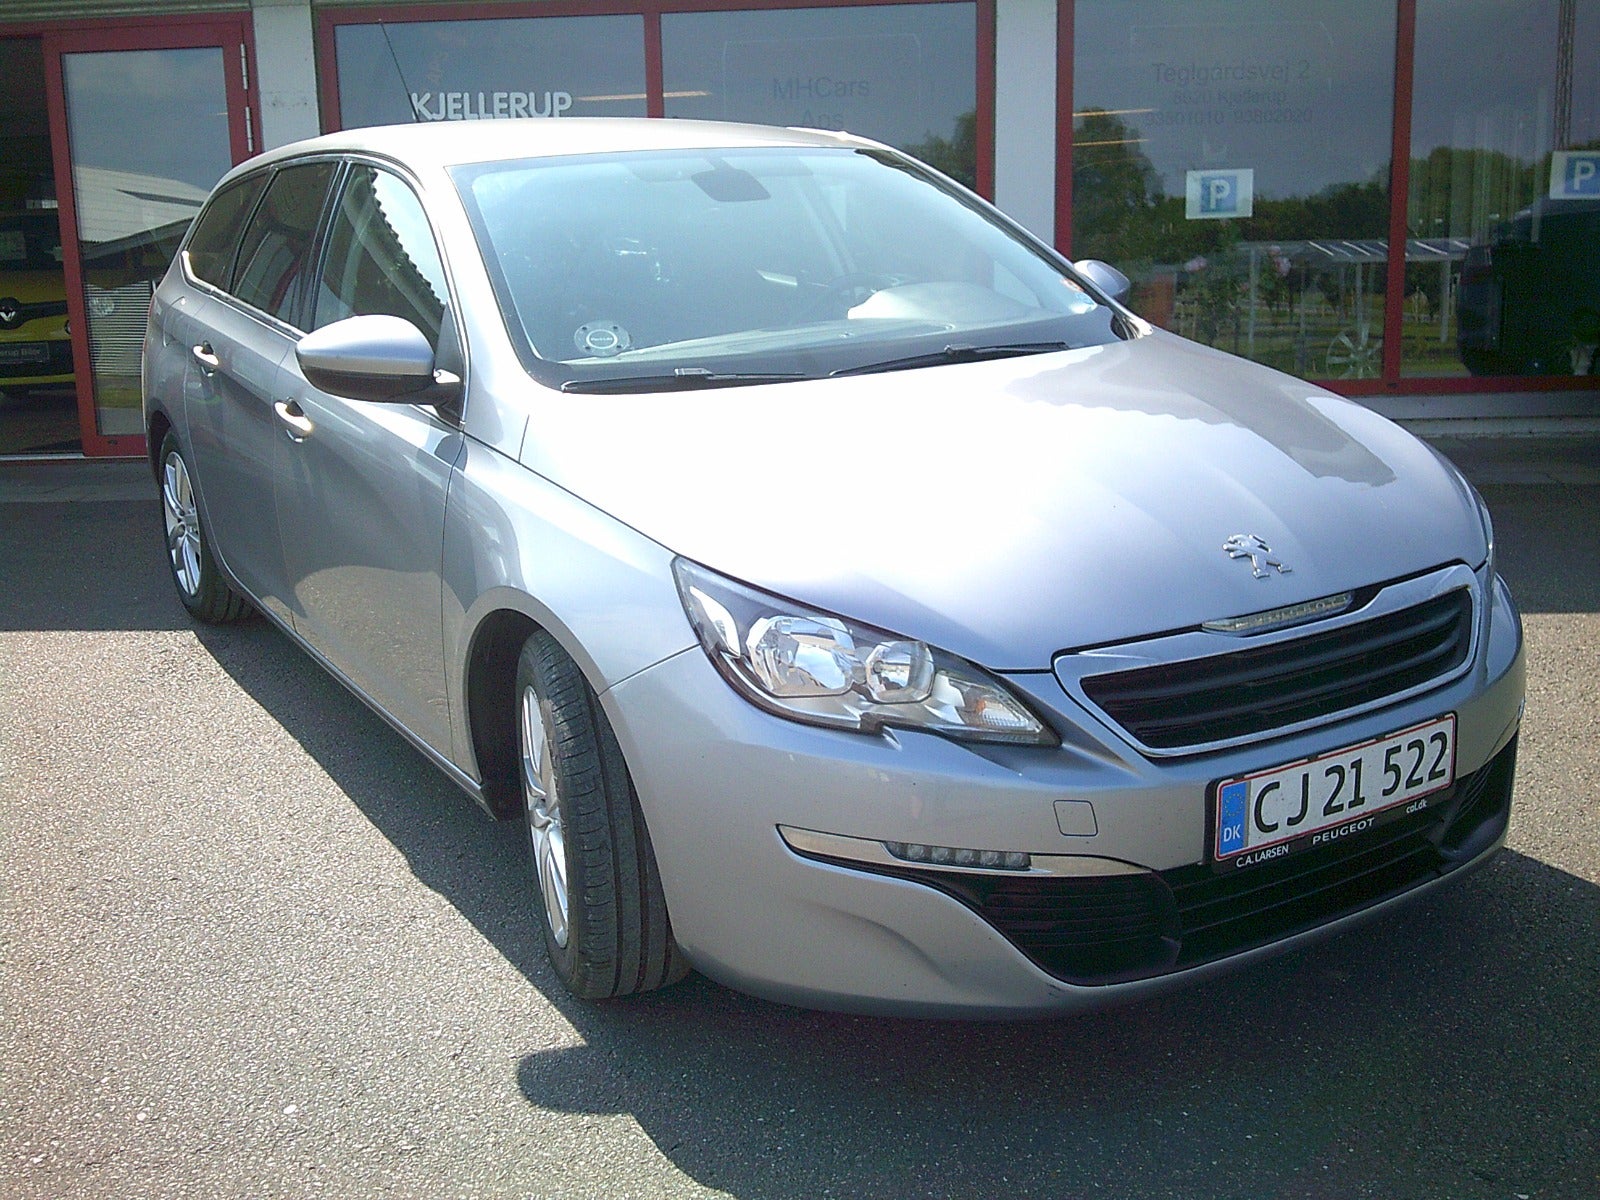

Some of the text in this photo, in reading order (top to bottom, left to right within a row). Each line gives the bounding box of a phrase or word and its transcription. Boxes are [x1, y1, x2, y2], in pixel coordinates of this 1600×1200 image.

[1298, 60, 1311, 79] 2
[773, 76, 870, 99] MHCars
[412, 92, 572, 120] KJELLERUP
[1574, 160, 1596, 190] P
[1210, 179, 1230, 209] P
[1253, 731, 1447, 833] CJ 21 522
[1223, 824, 1241, 842] DK
[1312, 817, 1375, 845] PEUGEOT
[1255, 843, 1289, 862] LARSEN
